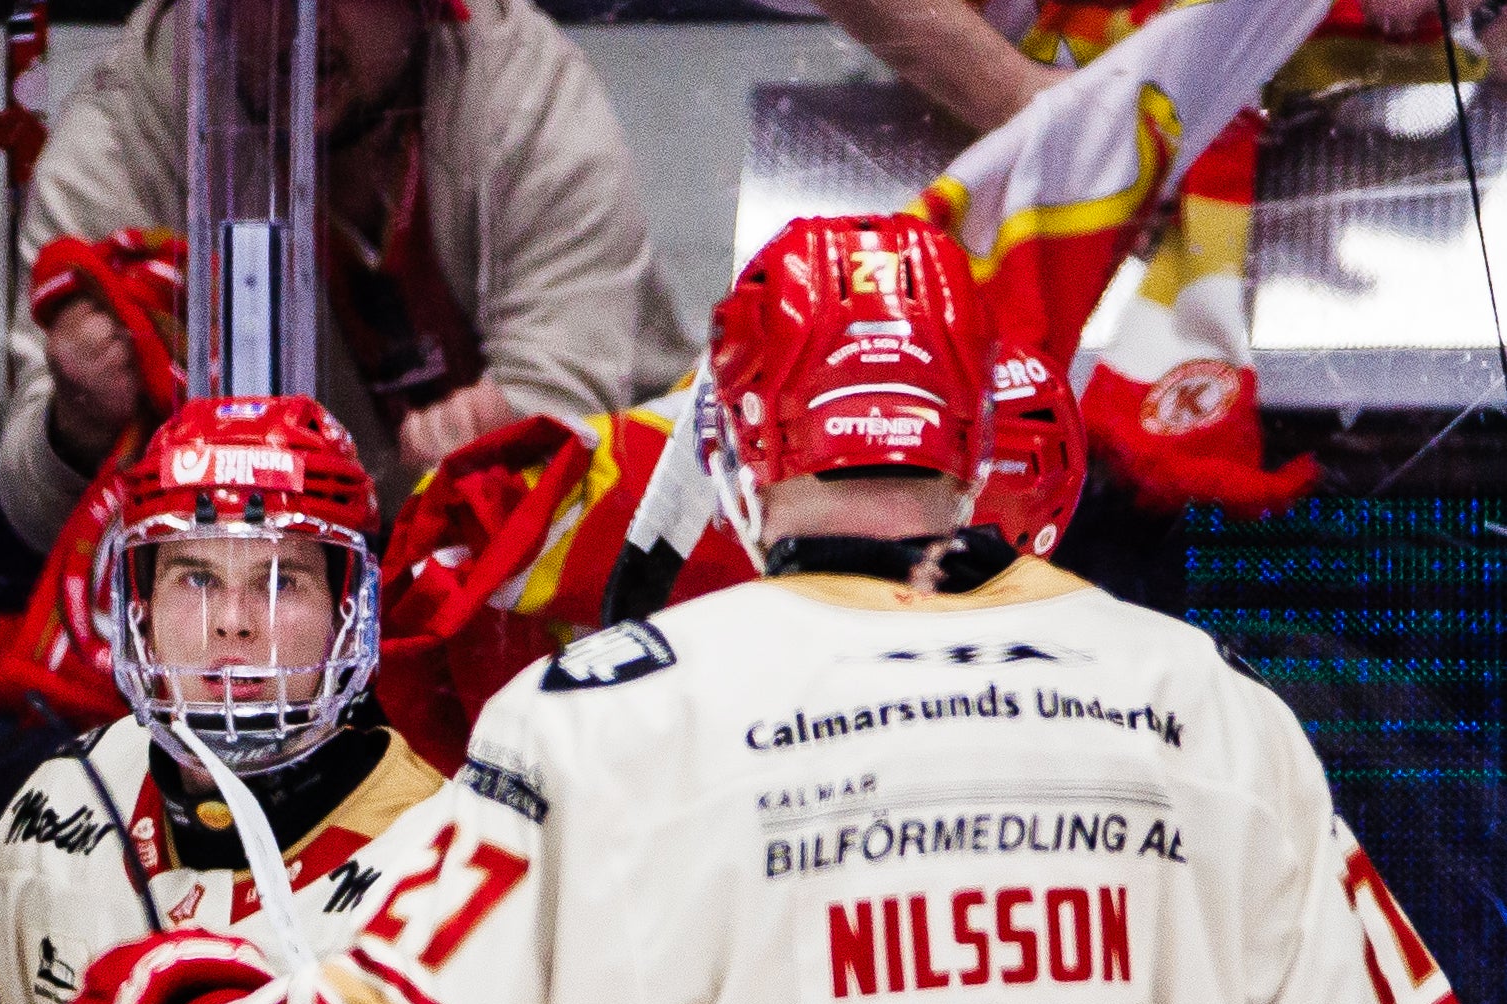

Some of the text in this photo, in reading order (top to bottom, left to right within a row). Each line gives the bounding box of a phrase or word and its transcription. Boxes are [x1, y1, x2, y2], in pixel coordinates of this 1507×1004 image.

[745, 684, 1022, 752] Calmarsunds
[3, 787, 115, 856] Molin
[764, 809, 1128, 878] BILFÖRMEDLING
[827, 885, 1132, 1000] NILSSON
